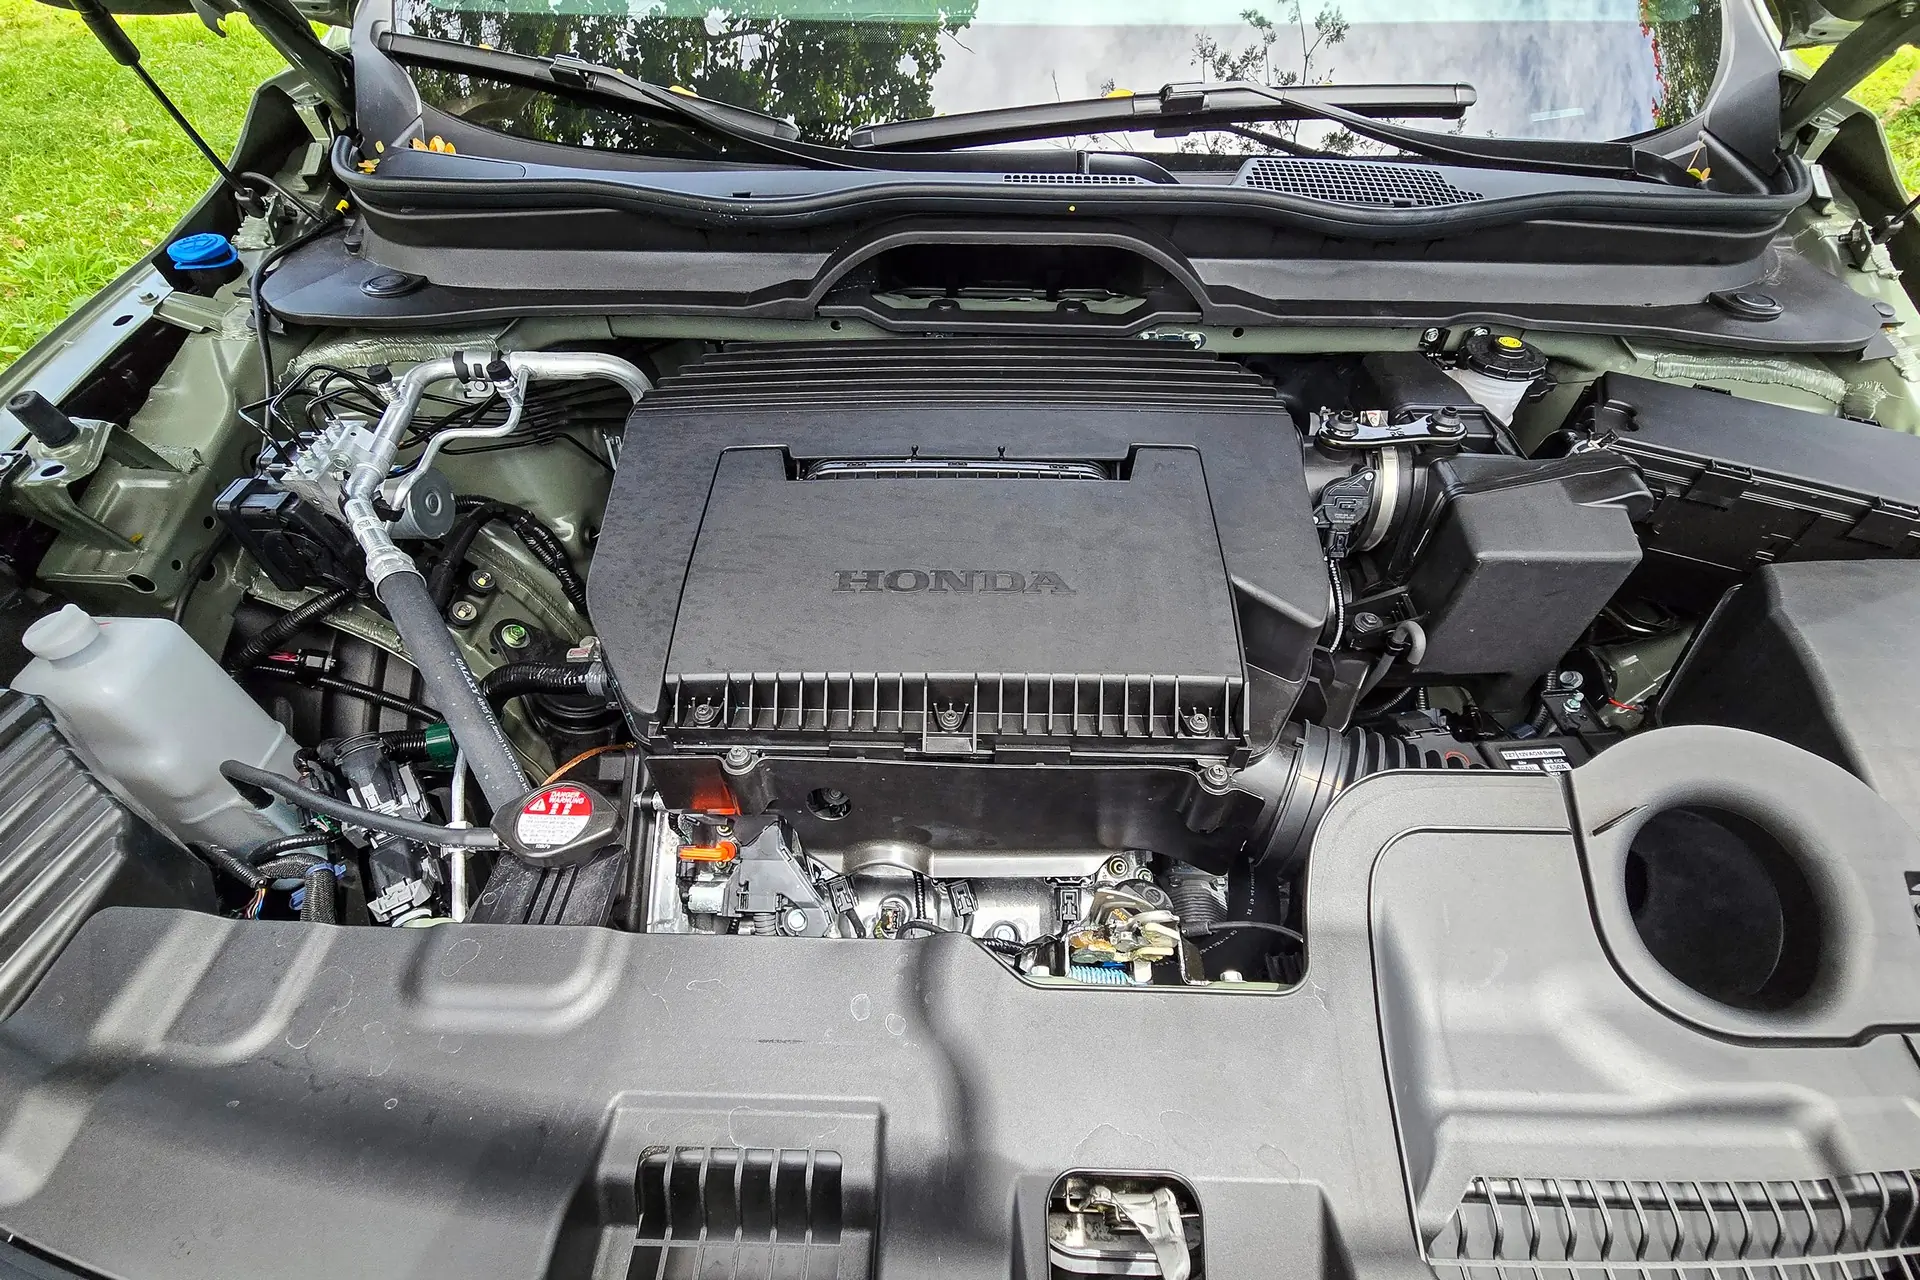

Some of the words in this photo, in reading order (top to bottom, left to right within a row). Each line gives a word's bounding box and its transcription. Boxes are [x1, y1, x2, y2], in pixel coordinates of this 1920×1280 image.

[832, 569, 1077, 595] HONDA
[455, 658, 480, 696] GALAXY
[548, 797, 585, 805] WARNING
[1111, 908, 1128, 922] SAE
